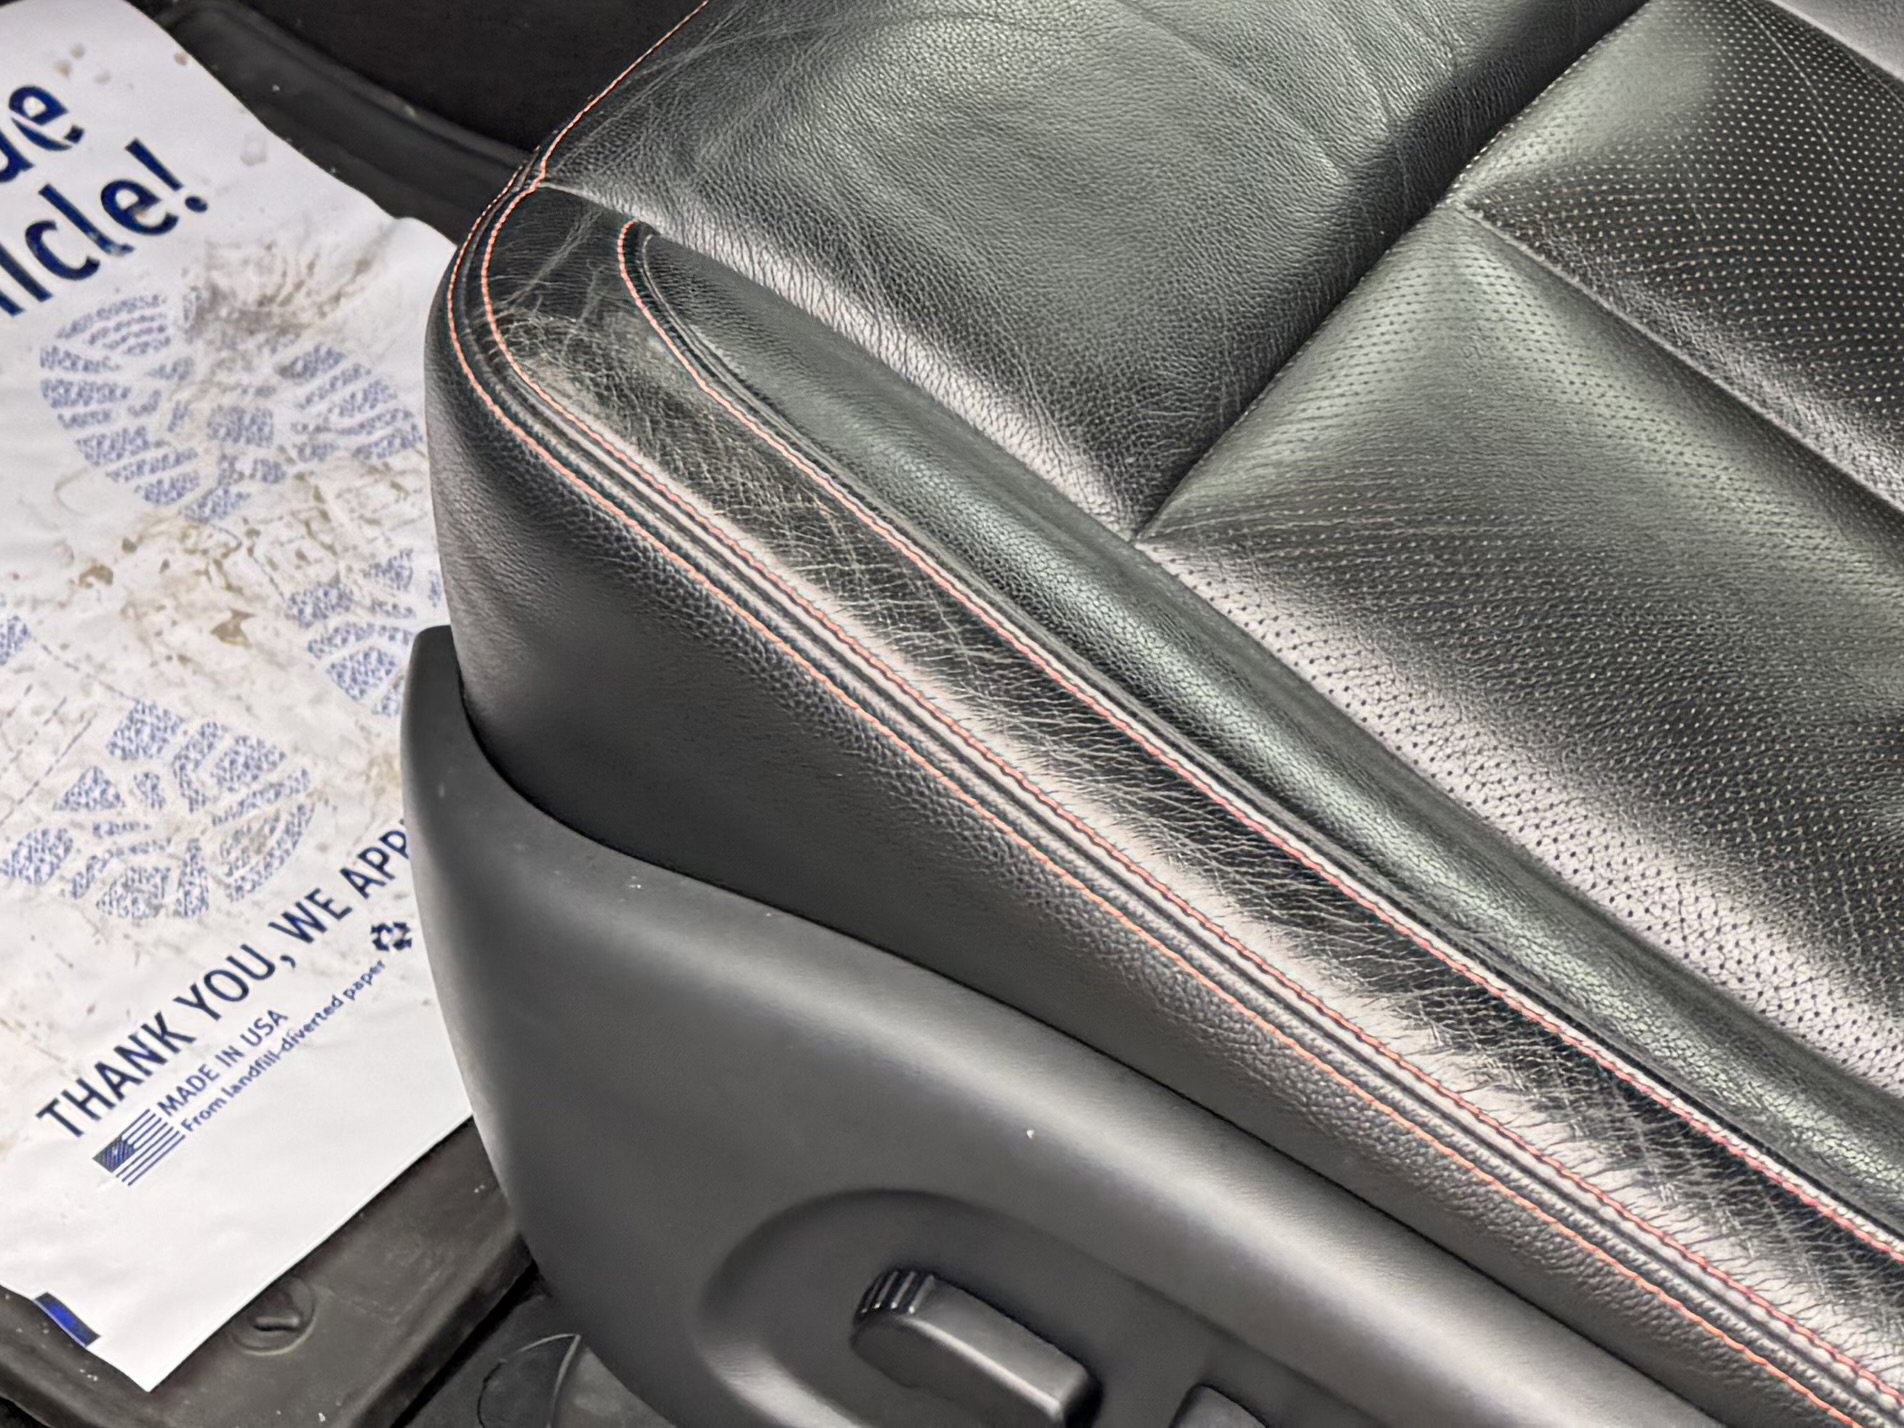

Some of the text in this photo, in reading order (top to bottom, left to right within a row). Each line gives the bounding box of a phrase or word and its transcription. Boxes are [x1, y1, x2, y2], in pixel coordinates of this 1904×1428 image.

[34, 1010, 198, 1139] THANK
[172, 943, 298, 1022] YOU,
[267, 887, 354, 945] WE
[157, 1008, 289, 1118] MADE IN USA
[180, 959, 386, 1133] From landfill-diverted paper
